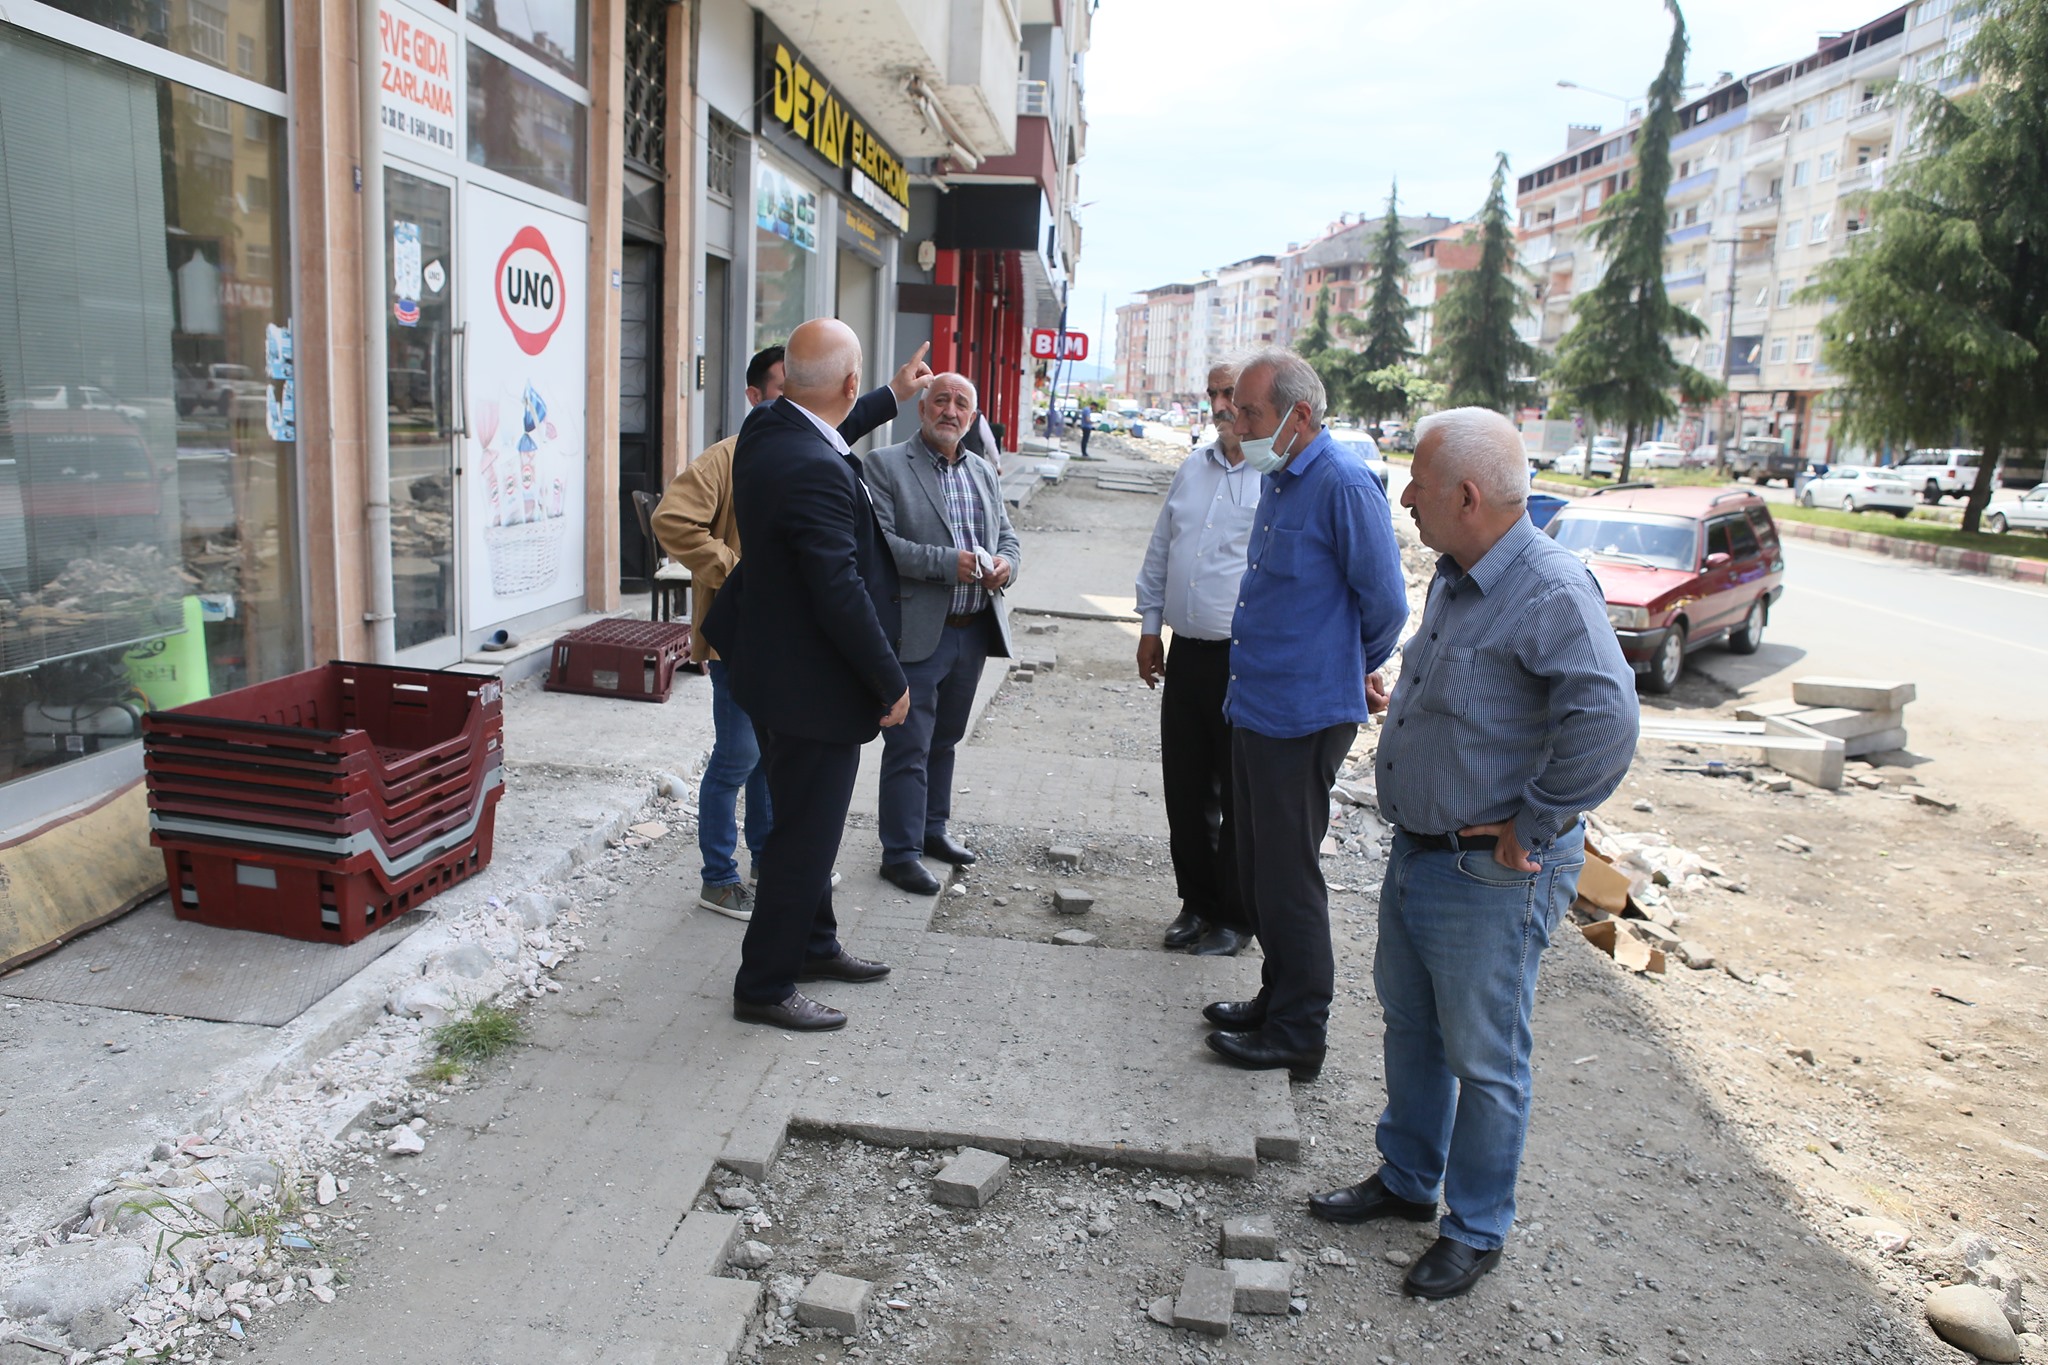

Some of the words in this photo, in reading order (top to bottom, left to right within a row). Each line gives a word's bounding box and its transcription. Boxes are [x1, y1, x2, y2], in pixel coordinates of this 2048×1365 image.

[414, 28, 449, 81] GIDA
[381, 60, 454, 118] ZARLAMA
[775, 43, 849, 168] DETAY
[508, 266, 554, 310] UNO
